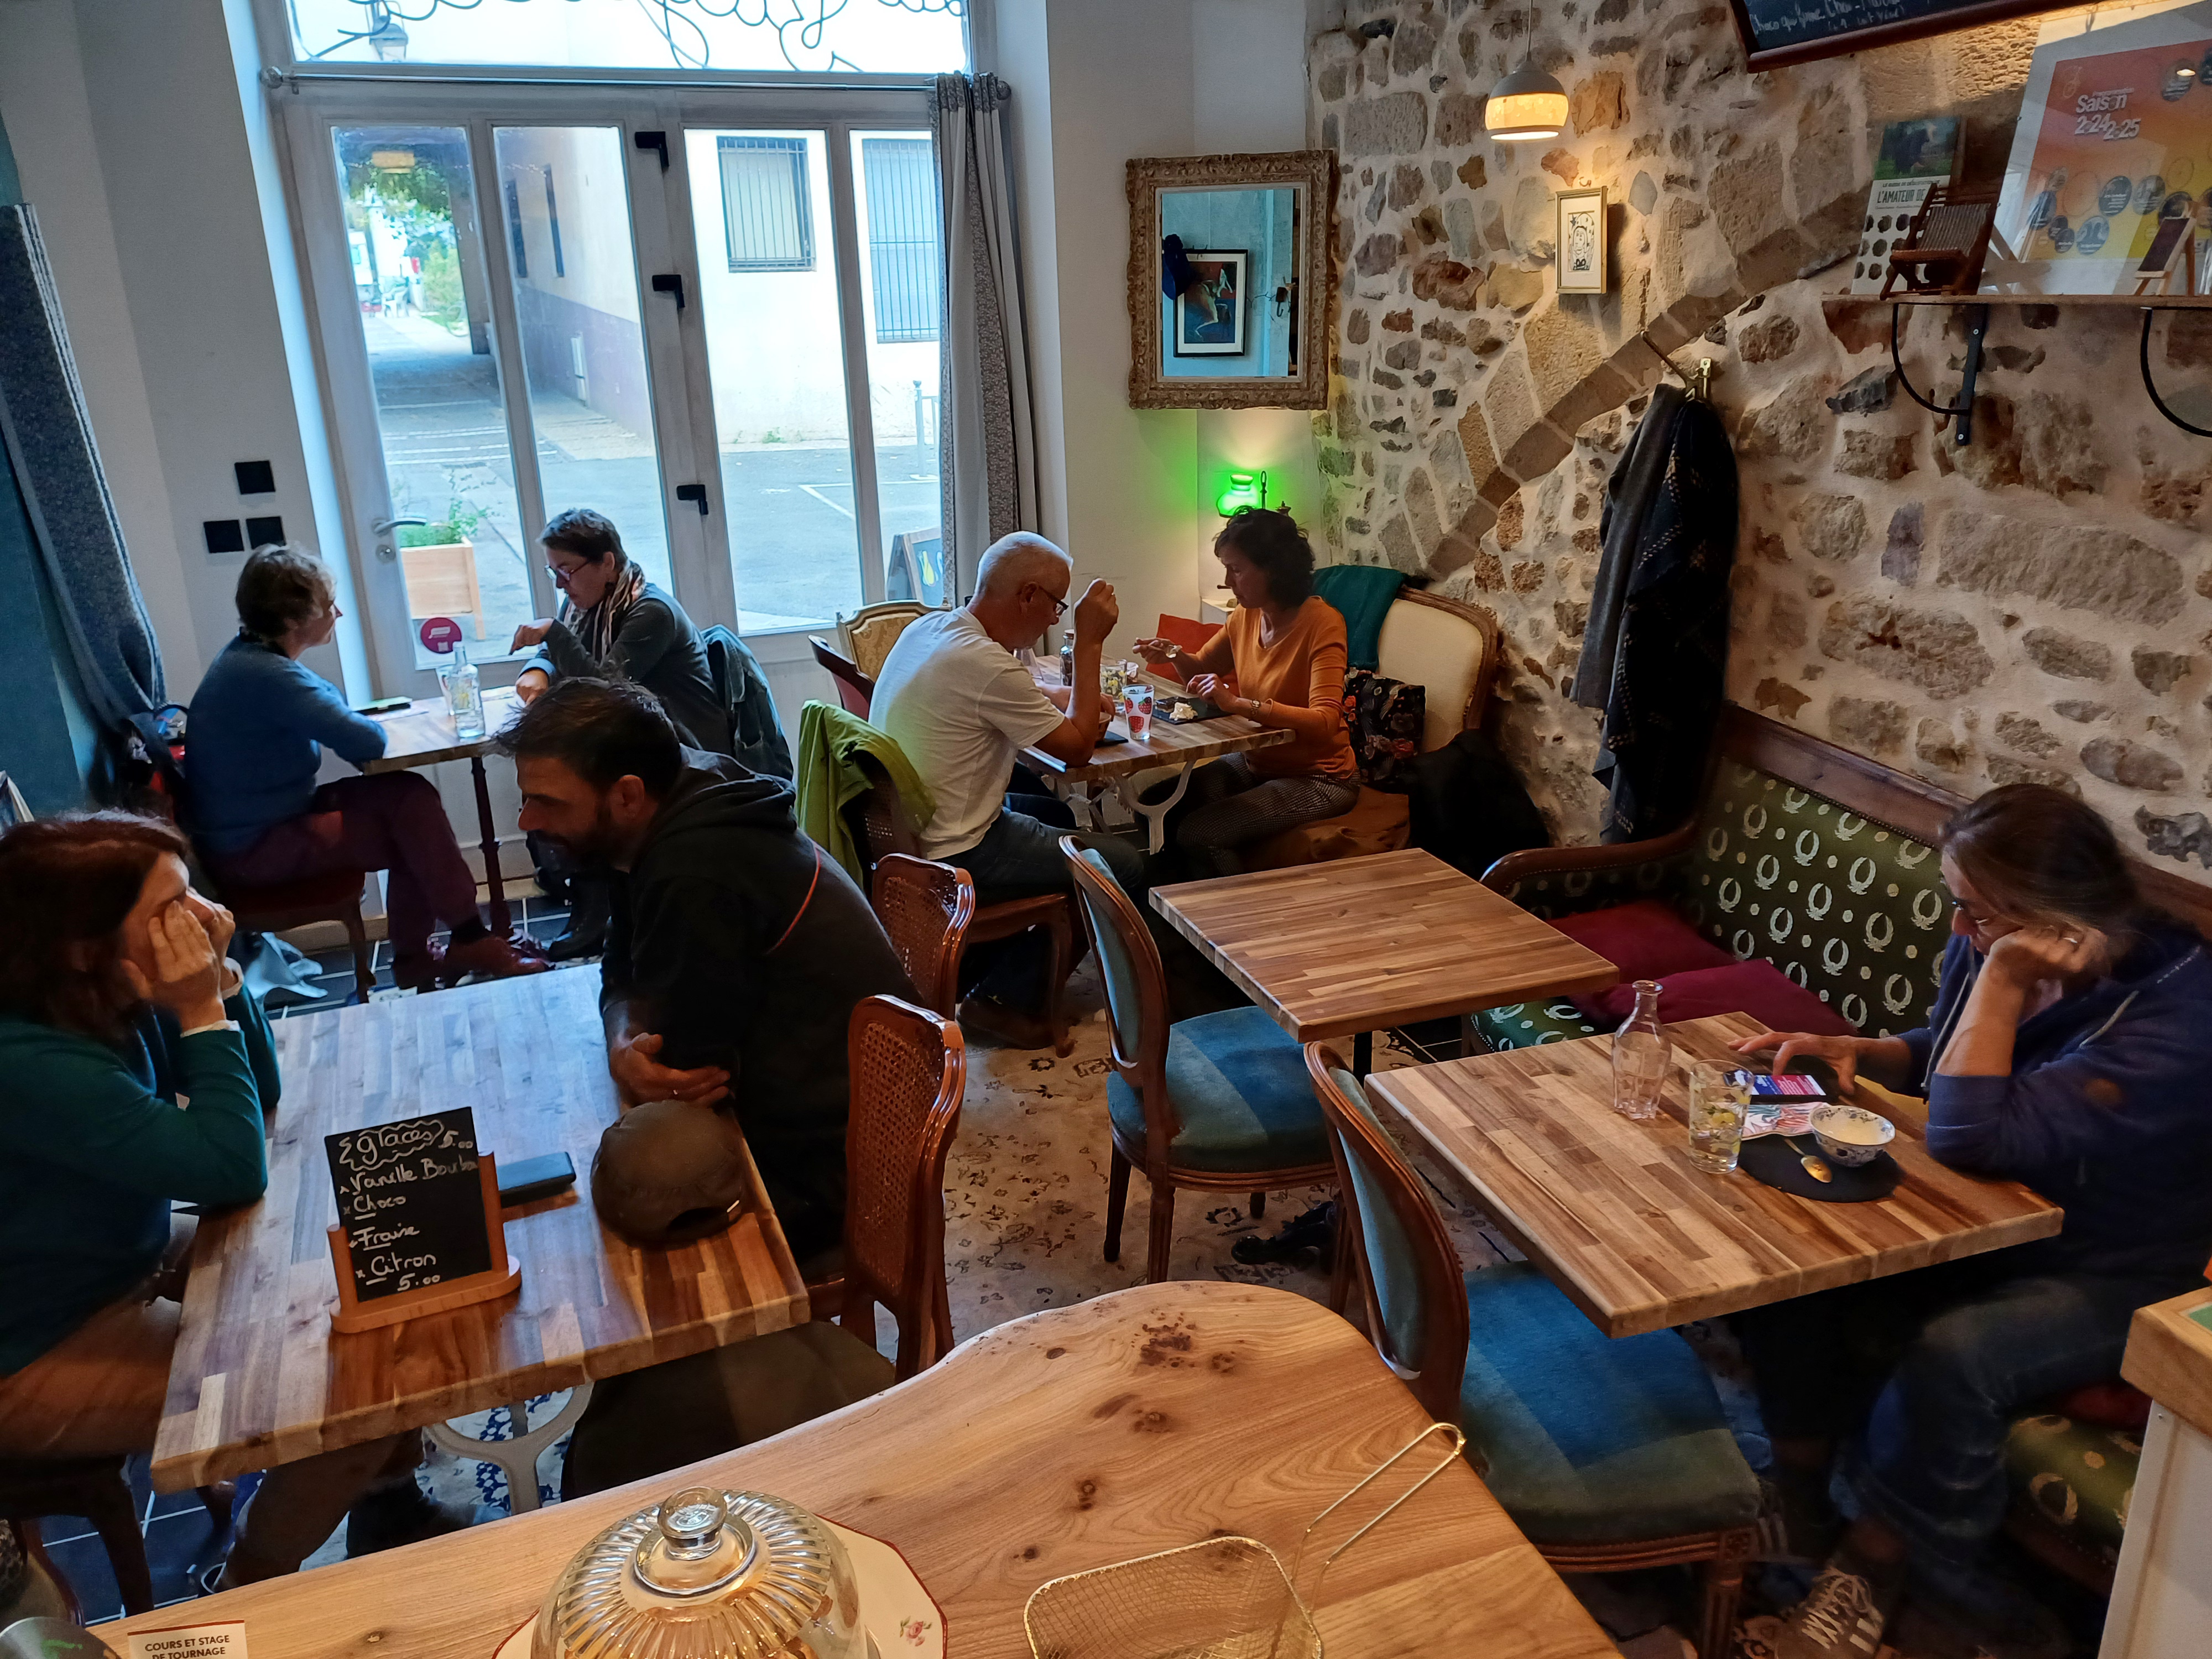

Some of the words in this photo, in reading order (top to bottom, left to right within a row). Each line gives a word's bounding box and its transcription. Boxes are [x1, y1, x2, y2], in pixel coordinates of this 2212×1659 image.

[2075, 95, 2127, 113] Saison
[1877, 189, 1915, 204] L'AMATEUR
[1916, 189, 1926, 201] DE
[439, 1130, 473, 1149] 5.00
[354, 1194, 406, 1212] Choco
[371, 1252, 436, 1276] Citron
[397, 1273, 440, 1291] 5.00
[145, 1640, 182, 1652] COURS
[185, 1639, 196, 1647] ET
[199, 1635, 230, 1646] STAGE
[168, 1647, 226, 1659] TOURNAGE
